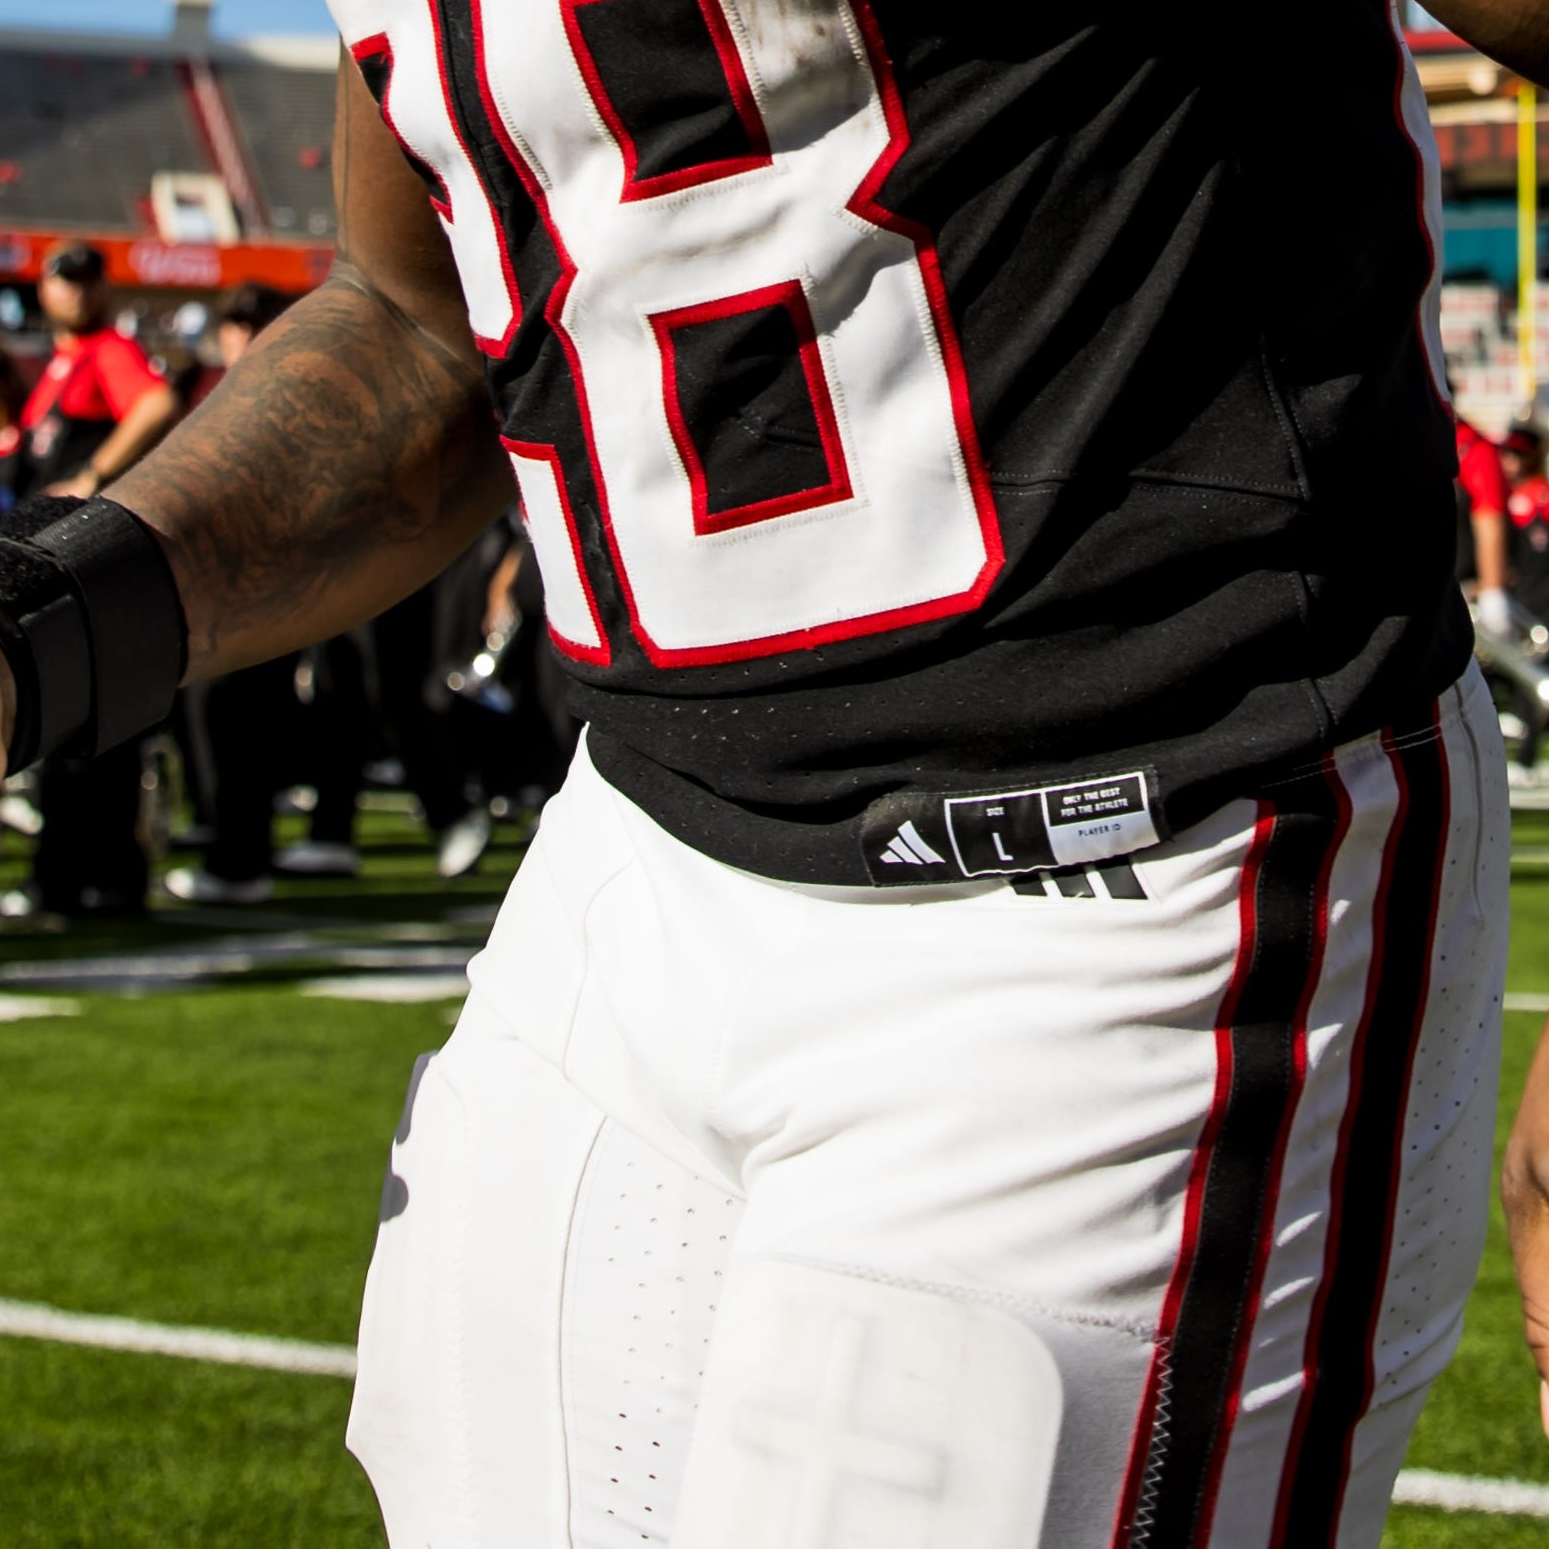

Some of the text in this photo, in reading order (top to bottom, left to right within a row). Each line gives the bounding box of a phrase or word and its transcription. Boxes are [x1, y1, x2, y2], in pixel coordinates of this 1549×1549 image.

[986, 806, 1004, 817] SIZE
[1078, 825, 1109, 836] PLAYER
[992, 832, 1014, 861] L
